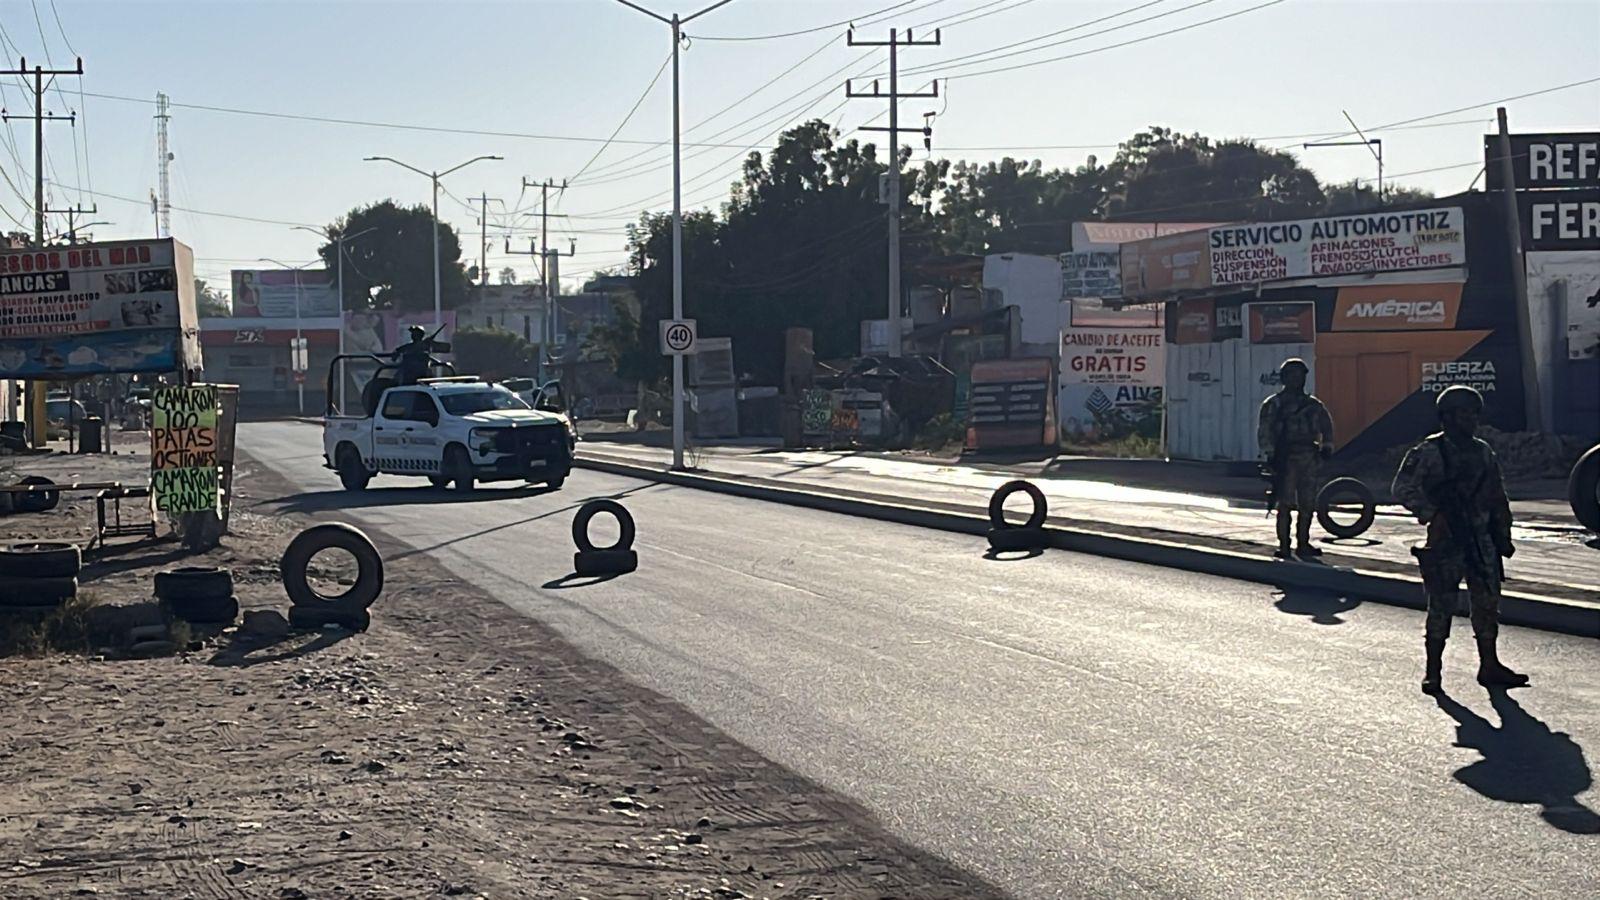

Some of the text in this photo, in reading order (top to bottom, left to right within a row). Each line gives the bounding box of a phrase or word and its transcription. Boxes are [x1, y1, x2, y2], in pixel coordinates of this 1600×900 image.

[1530, 143, 1600, 180] REF
[1211, 223, 1303, 249] SERVICIO
[1311, 211, 1450, 241] AUTOMOTRIZ
[1311, 238, 1395, 253] AFINACIONES
[1311, 251, 1359, 264] FRENOS
[1372, 246, 1419, 259] CLUTCH
[68, 249, 102, 269] DEL
[1346, 300, 1445, 317] AMÉRICA
[670, 329, 688, 342] 40
[1064, 333, 1161, 347] CAMBIO DE ACEITE
[1071, 355, 1147, 372] GRATIS
[1421, 361, 1496, 374] FUERZA
[154, 388, 216, 412] CAMARON
[155, 428, 214, 449] PATAS
[155, 448, 217, 469] OSTIONES
[154, 468, 217, 494] CAMARON
[157, 492, 217, 511] GRANDE
